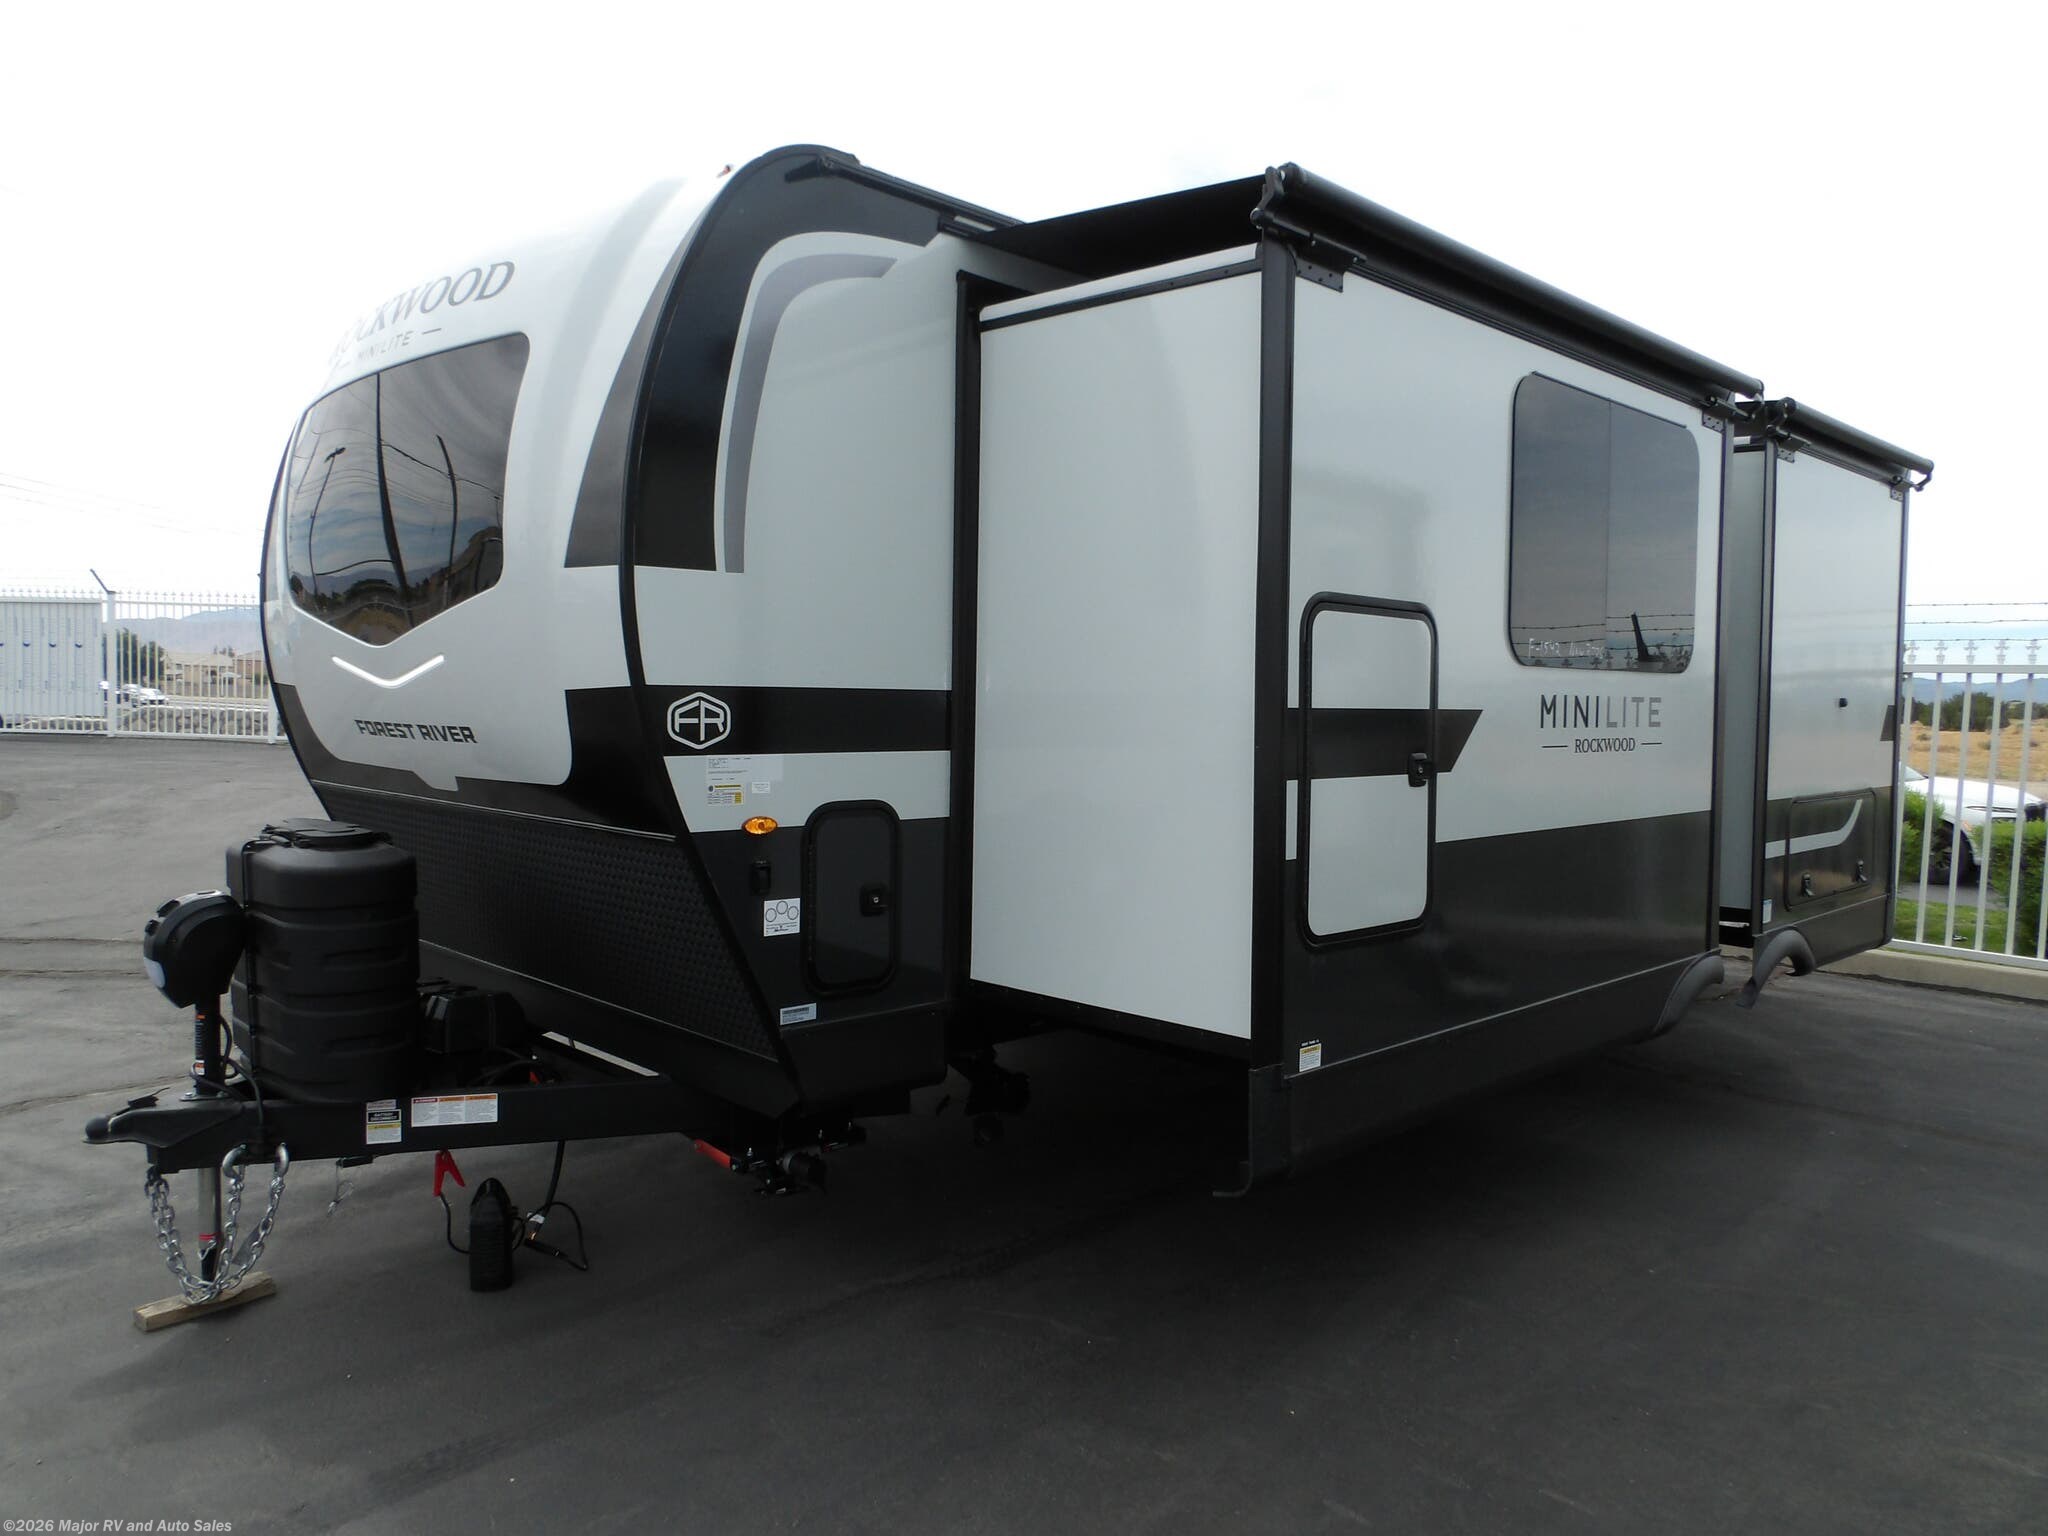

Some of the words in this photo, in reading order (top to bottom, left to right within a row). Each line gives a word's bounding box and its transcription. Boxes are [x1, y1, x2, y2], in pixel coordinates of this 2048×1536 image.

[354, 719, 416, 740] FOREST
[416, 724, 479, 744] RIVER
[1574, 738, 1636, 753] ROCKWOOD
